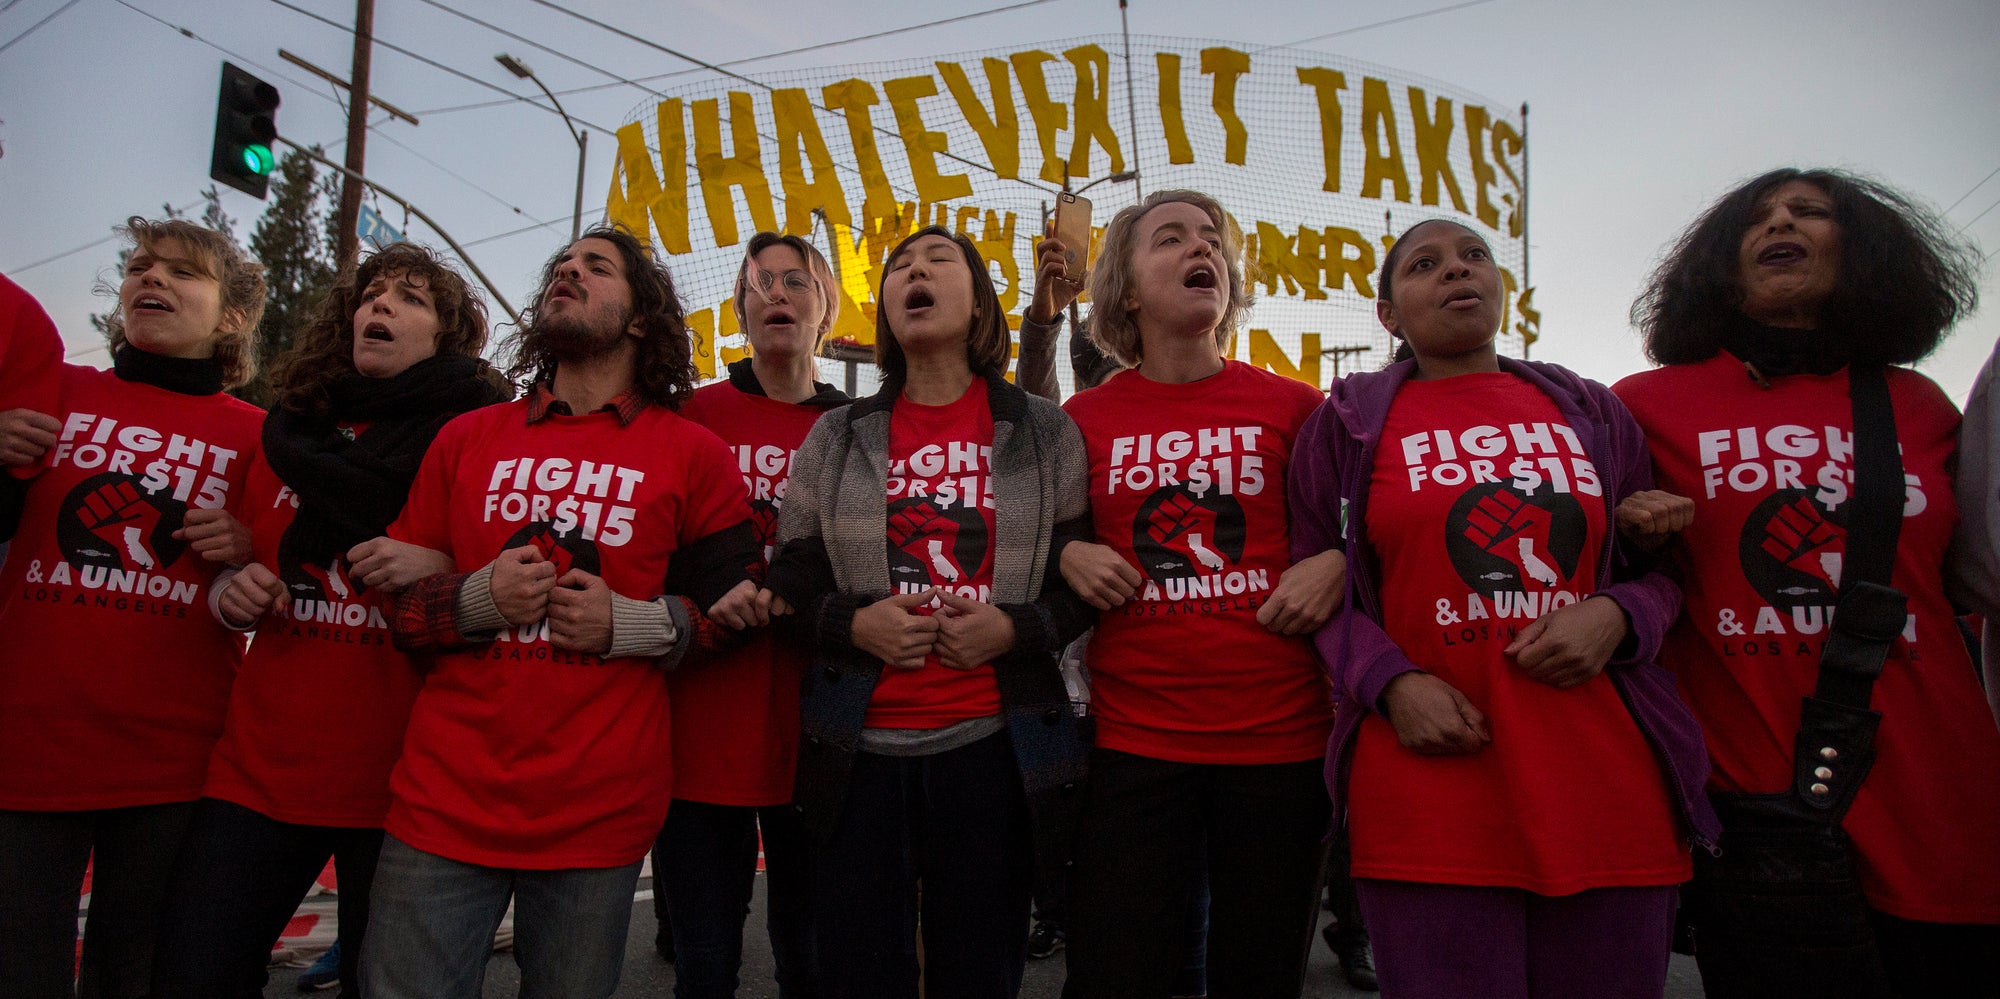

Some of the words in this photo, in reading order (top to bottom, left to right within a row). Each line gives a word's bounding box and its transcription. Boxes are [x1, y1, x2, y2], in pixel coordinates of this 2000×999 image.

[607, 43, 1125, 257] WHATEVER
[1156, 47, 1250, 165] IT
[1296, 66, 1523, 238] TAKES
[60, 412, 237, 475] FIGHT
[1110, 426, 1262, 467] FIGHT
[1401, 422, 1585, 466] FIGHT
[1698, 424, 1903, 466] FIGH
[52, 443, 136, 475] FOR
[140, 458, 229, 510] $15
[487, 457, 645, 502] FIGHT
[887, 477, 929, 498] OR
[1108, 463, 1180, 495] FOR
[1187, 455, 1265, 499] $15
[1408, 459, 1502, 492] FOR
[1509, 456, 1602, 497] $15
[1703, 459, 1806, 499] FOR
[484, 492, 551, 523] FOR
[552, 495, 636, 547] $15
[26, 559, 44, 584] &
[48, 562, 72, 586] A
[80, 565, 198, 605] UNION
[1142, 579, 1161, 601] A
[1165, 569, 1269, 601] UNION
[23, 588, 62, 603] LOS
[73, 593, 187, 619] ANGELES
[1435, 598, 1462, 626] &
[1467, 593, 1489, 620] A
[1717, 608, 1746, 636] &
[1753, 606, 1786, 635] A
[1443, 625, 1488, 646] LOS
[1723, 641, 1781, 657] LOS
